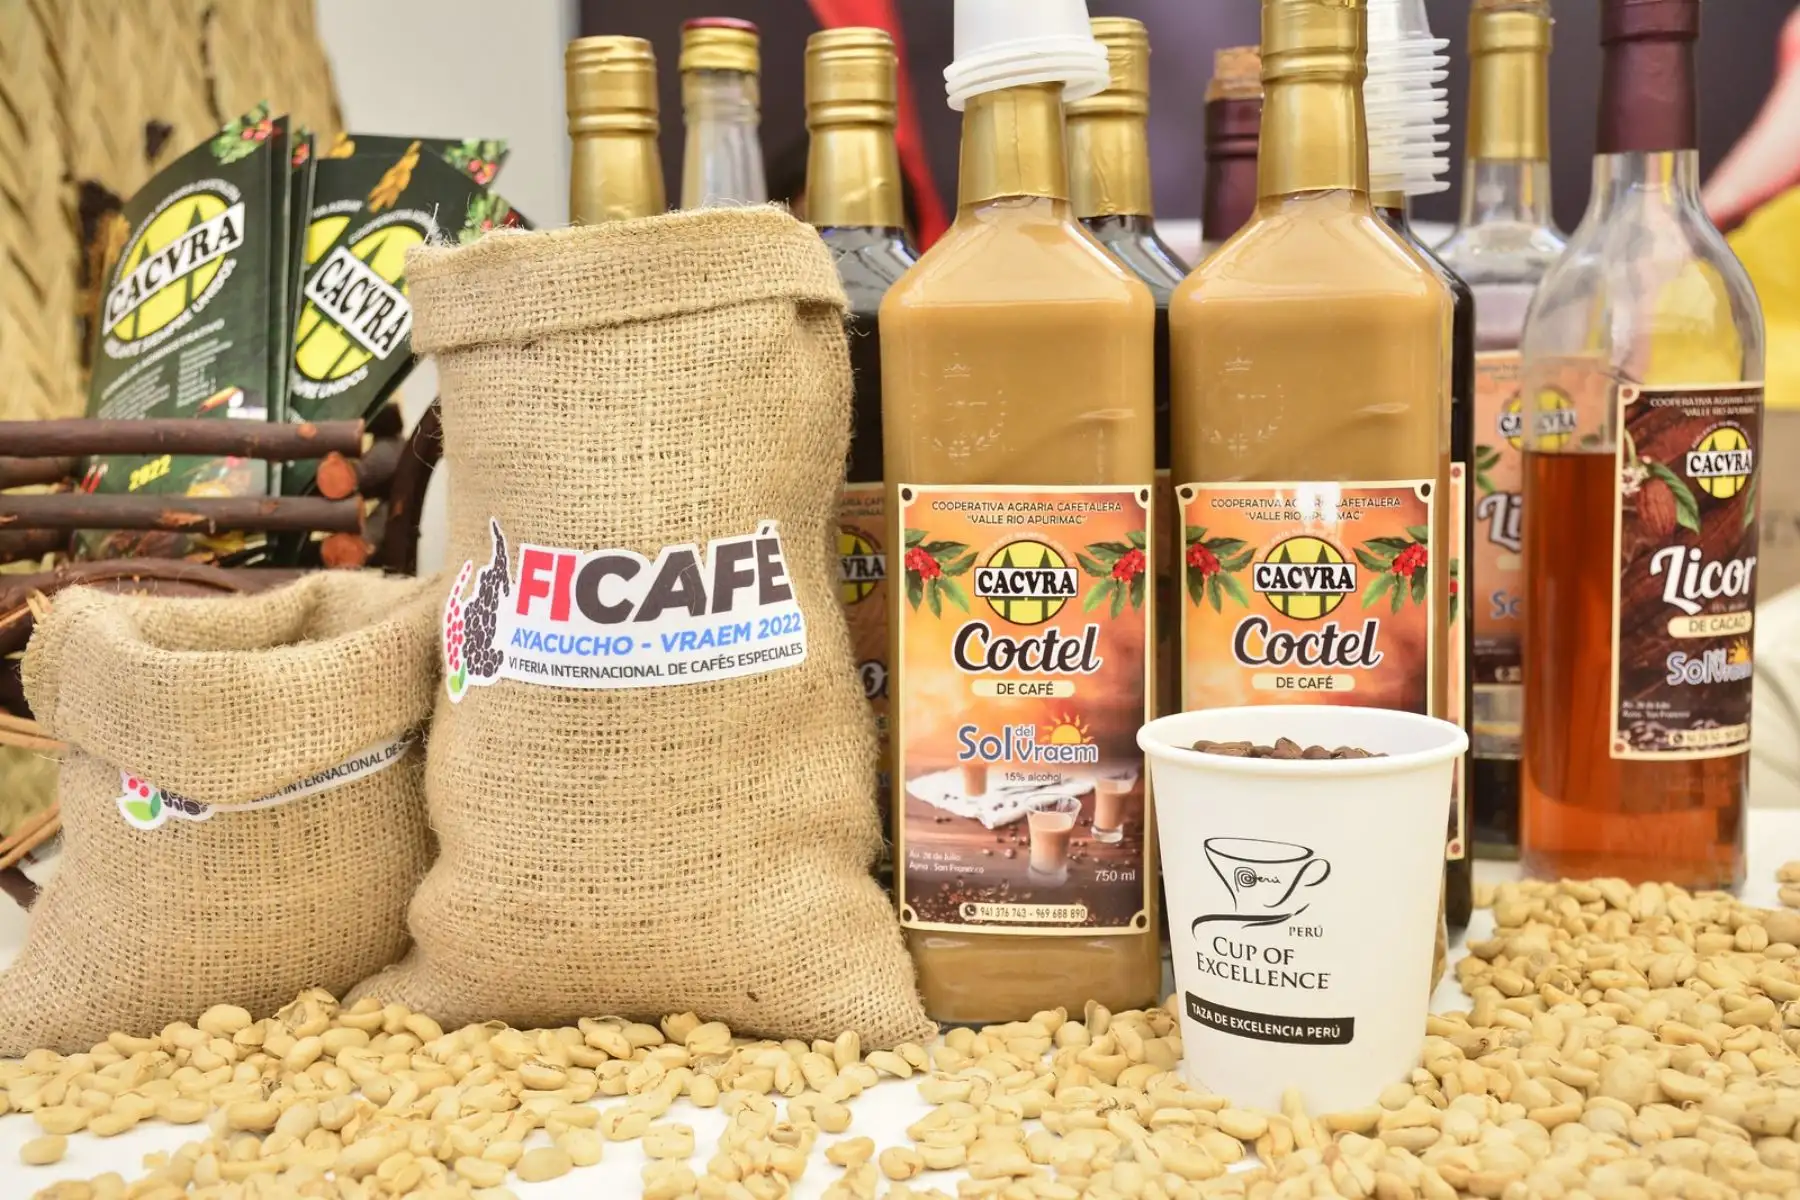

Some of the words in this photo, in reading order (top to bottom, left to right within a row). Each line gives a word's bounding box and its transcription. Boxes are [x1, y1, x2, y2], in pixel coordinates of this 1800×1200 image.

[109, 215, 238, 322] CACVRA
[315, 257, 409, 352] CACVRA
[128, 454, 171, 492] 2022
[1690, 453, 1751, 473] CACVRA
[932, 501, 1004, 511] COOPERATIVA
[1008, 502, 1054, 511] AGRARIA
[1057, 502, 1122, 512] CAFETALERA
[1211, 498, 1281, 508] COOPERATIVA
[967, 515, 1003, 524] "VALLE
[1006, 515, 1025, 525] RIO
[1027, 515, 1087, 525] APURIMAC"
[1246, 511, 1281, 521] "VALLE
[1283, 511, 1300, 521] RIO
[515, 526, 793, 625] FICAFÉ
[978, 570, 1076, 595] CACVRA
[1256, 567, 1354, 590] CACVRA
[1651, 545, 1757, 615] Licor
[511, 628, 634, 657] AYACUCHO
[660, 625, 751, 654] VRAEM
[758, 612, 801, 640] 2022
[1689, 620, 1706, 633] DE
[1710, 616, 1746, 631] CACAO
[954, 622, 1101, 671] Coctel
[1234, 616, 1382, 666] Coctel
[508, 656, 518, 670] VI
[519, 659, 548, 675] FERIA
[551, 663, 665, 679] INTERNACIONAL
[669, 662, 687, 676] DE
[691, 653, 735, 673] CAFÉS
[738, 645, 803, 669] ESPECIALES
[996, 683, 1015, 695] DE
[1018, 681, 1054, 696] CAFÉ
[1276, 677, 1295, 689] DE
[1298, 675, 1334, 689] CAFÉ
[958, 725, 1011, 761] Sol
[1015, 725, 1034, 737] del
[1016, 738, 1097, 762] Vraem
[1004, 772, 1025, 782] 15%
[1027, 772, 1062, 782] alcohol
[934, 863, 948, 872] San
[1094, 870, 1118, 882] 750
[1121, 870, 1136, 881] ml
[980, 906, 993, 916] 941
[996, 906, 1009, 917] 376
[1011, 907, 1026, 918] 743
[1036, 908, 1050, 919] 969
[1053, 908, 1067, 919] 688
[1071, 908, 1085, 919] 890
[1289, 924, 1323, 937] PERÚ
[1213, 936, 1257, 961] CUP
[1263, 947, 1295, 965] OF
[1196, 951, 1331, 989] EXCELLENCE
[1191, 1003, 1212, 1021] TAZA
[1214, 1012, 1228, 1026] DE
[1230, 1017, 1304, 1037] EXCELENCIA
[1307, 1024, 1341, 1038] PERÚ
